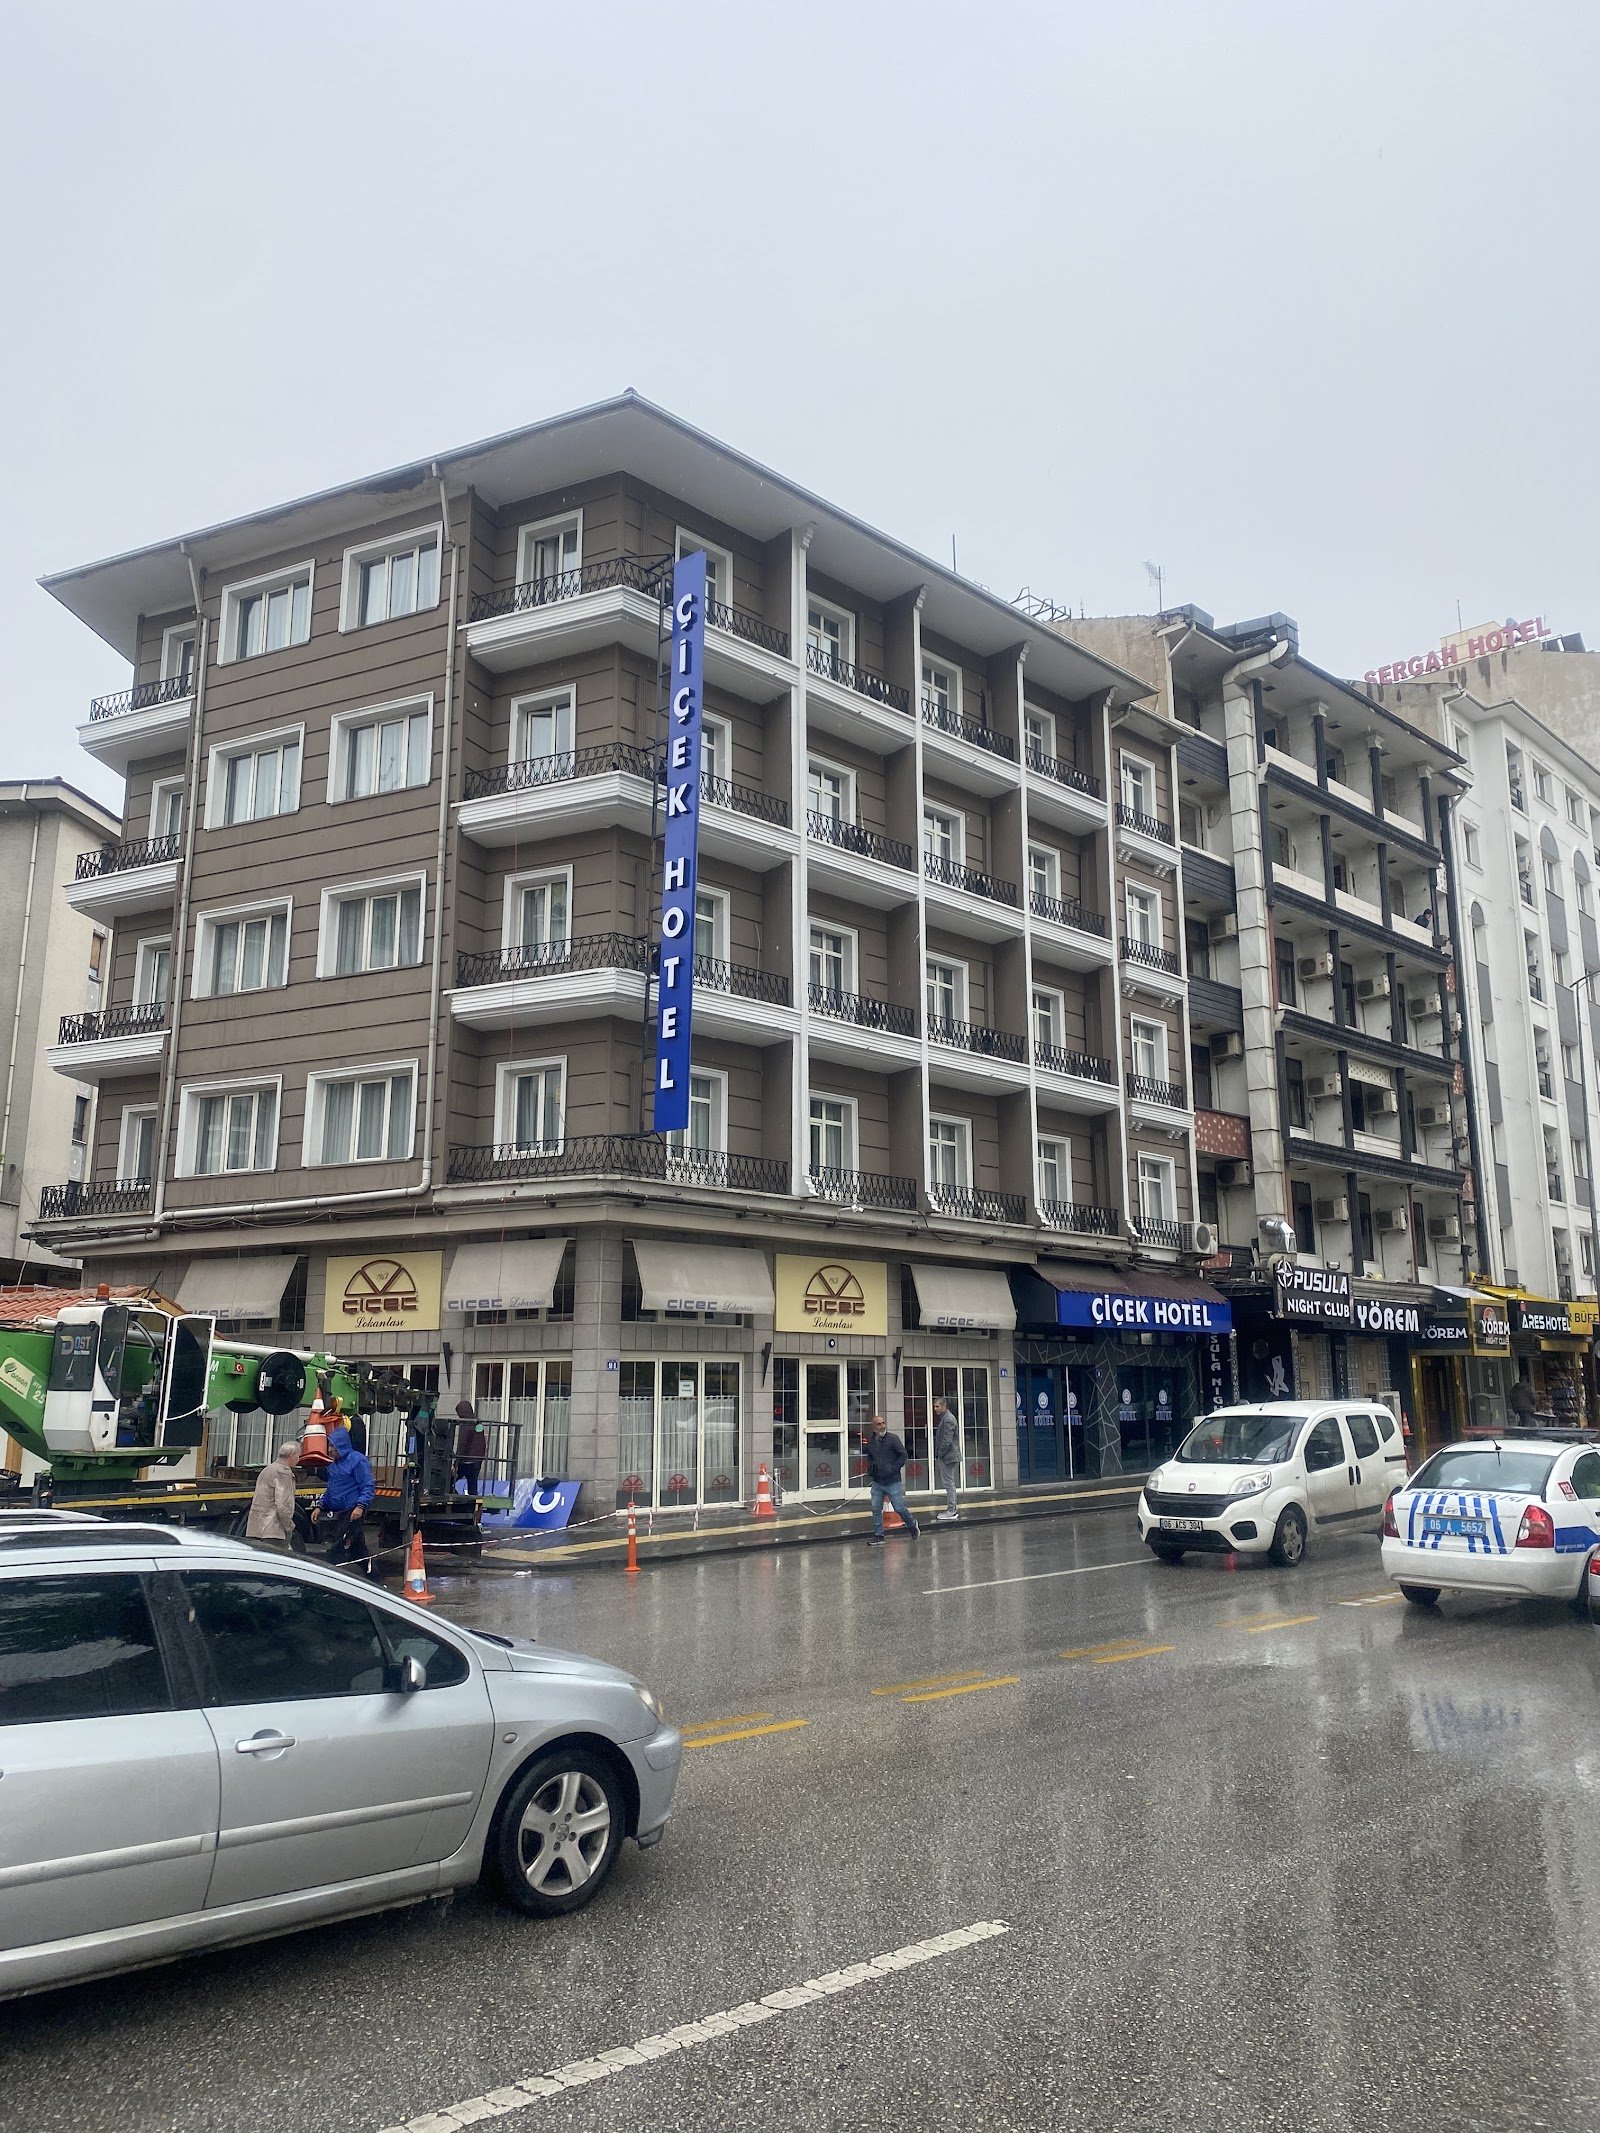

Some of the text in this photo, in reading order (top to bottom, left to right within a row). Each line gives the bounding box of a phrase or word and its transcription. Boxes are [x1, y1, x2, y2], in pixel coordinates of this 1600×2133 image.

[1364, 616, 1552, 685] SERGAH HOTEL
[660, 593, 693, 1090] ÇİÇEK HOTEL
[1294, 1270, 1348, 1295] PUSULA
[1092, 1294, 1212, 1327] ÇİÇEK HOTEL
[1287, 1298, 1350, 1318] NIGHT CLUB
[1357, 1301, 1419, 1332] YÖREM
[354, 1316, 406, 1329] Lokantası
[812, 1316, 853, 1329] Lokantası
[1481, 1319, 1511, 1335] YÖREM
[1522, 1314, 1545, 1330] ARES
[1545, 1316, 1571, 1331] HOTEL
[1485, 1336, 1498, 1345] NIGHT
[32, 1389, 46, 1405] 25
[1430, 1519, 1441, 1531] 06
[1446, 1520, 1452, 1531] A
[1461, 1521, 1484, 1534] 5652
